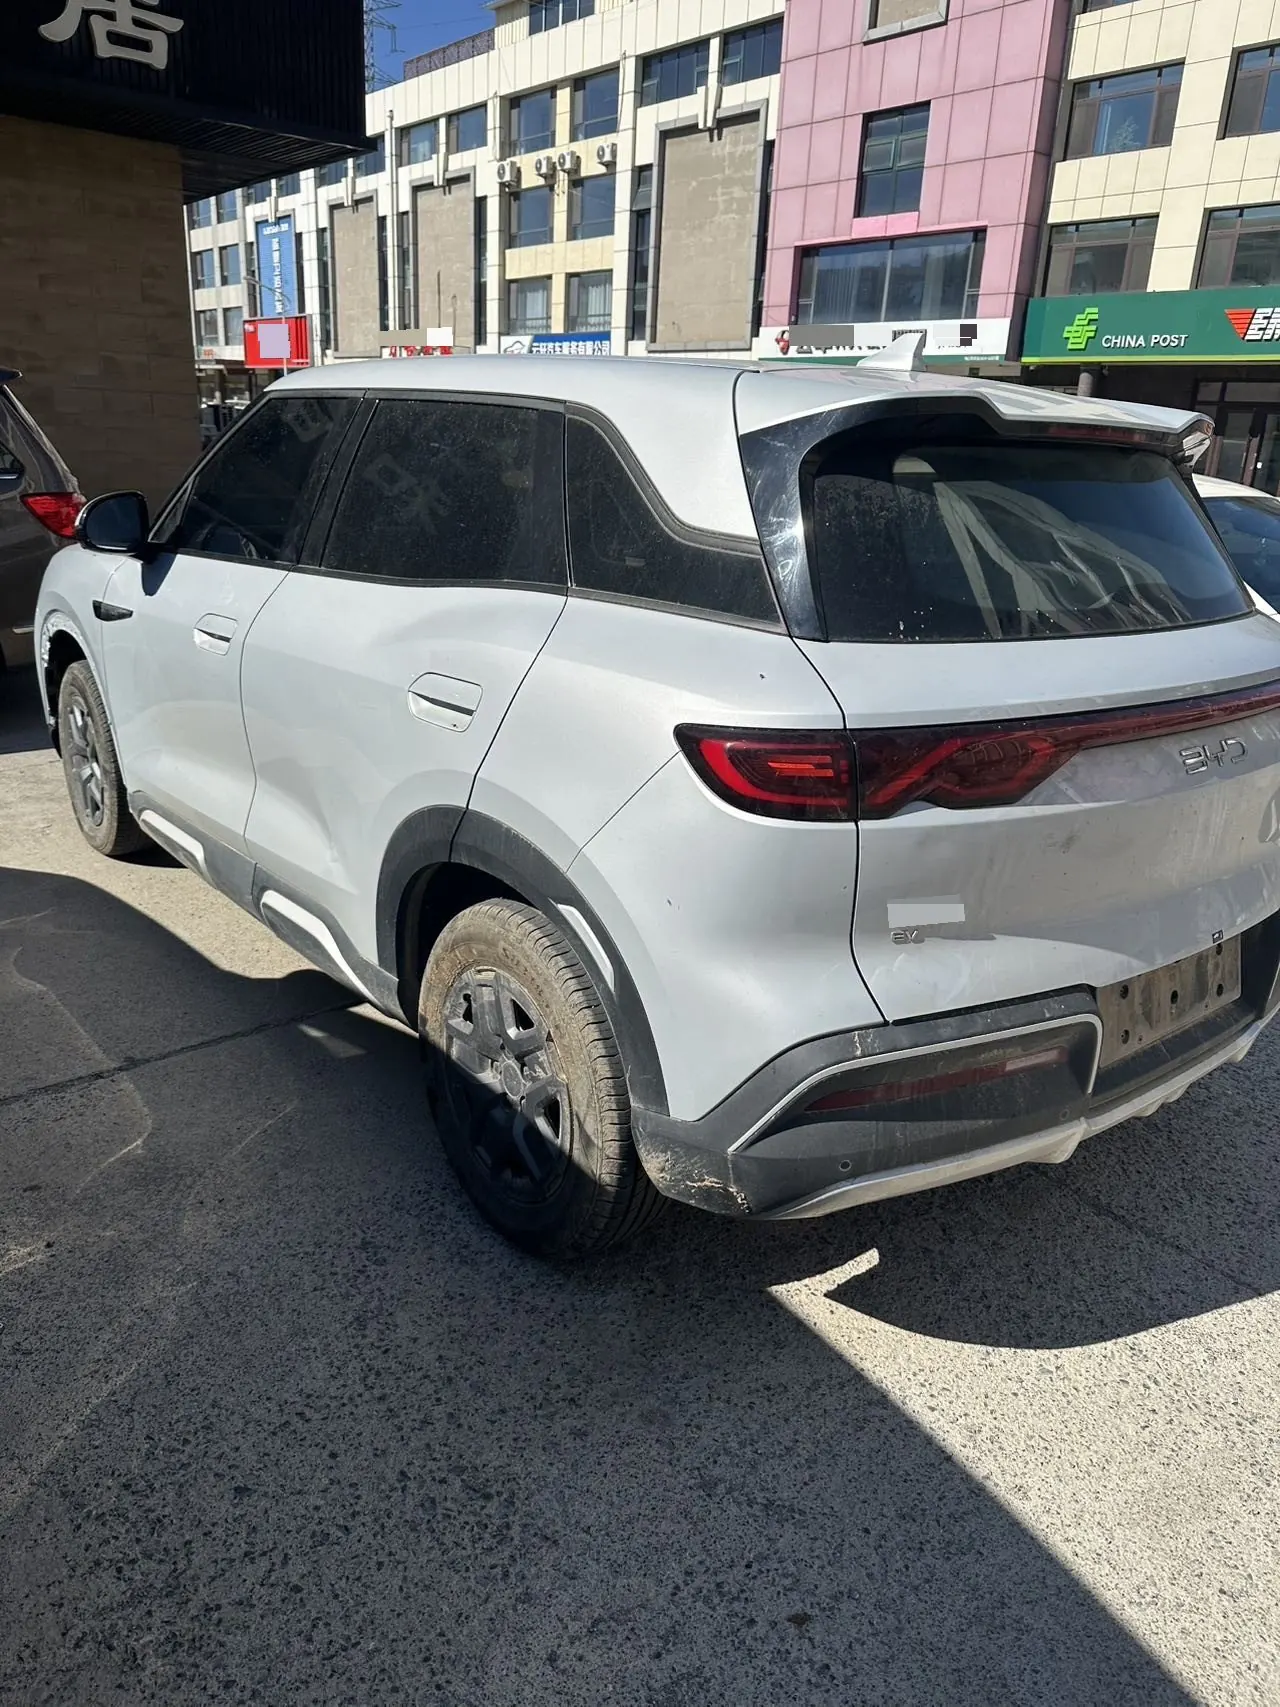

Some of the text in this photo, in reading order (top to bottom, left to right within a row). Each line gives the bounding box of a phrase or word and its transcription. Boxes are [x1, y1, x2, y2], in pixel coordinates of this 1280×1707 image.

[1101, 334, 1188, 348] CHINA POST
[1179, 737, 1247, 775] BYD
[890, 929, 919, 945] EV
